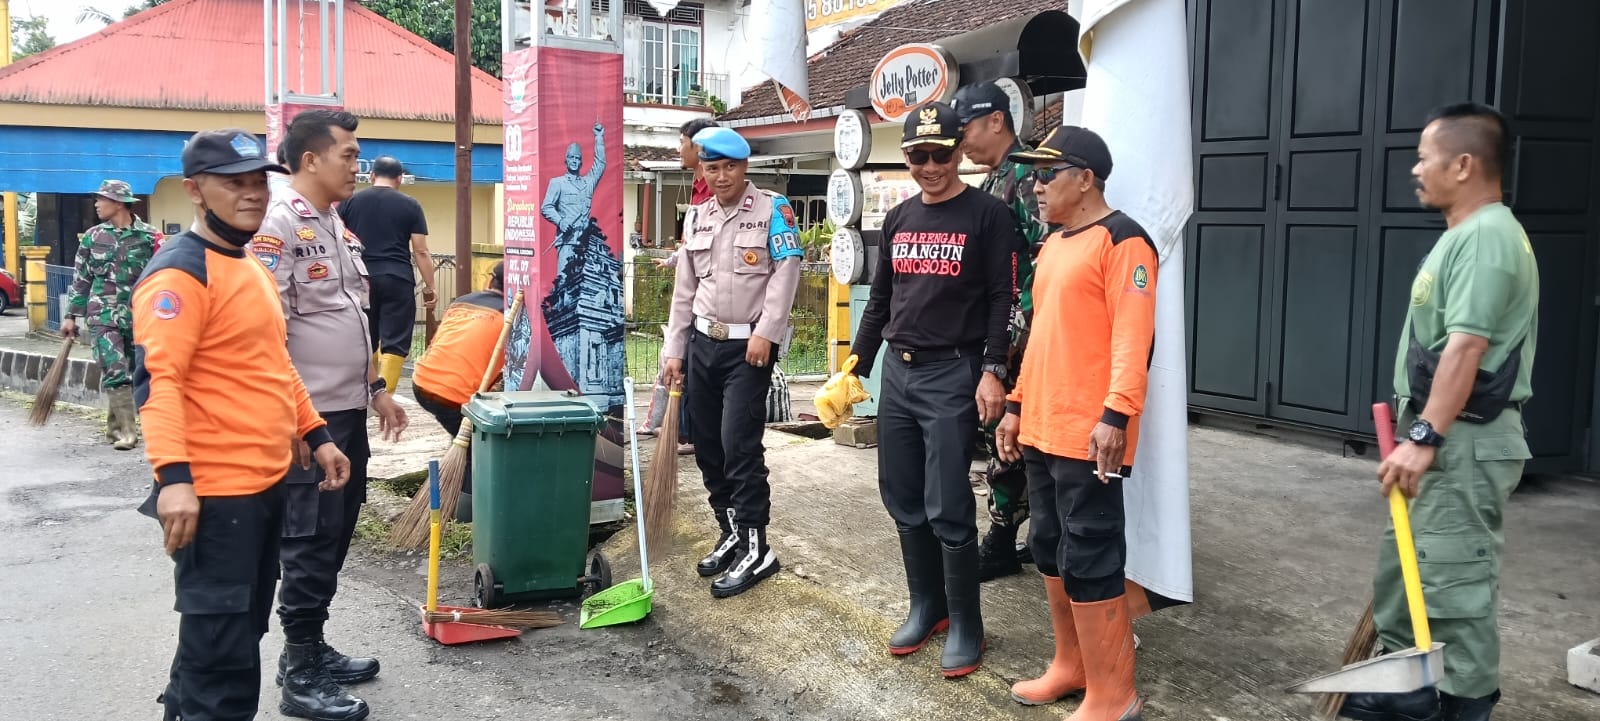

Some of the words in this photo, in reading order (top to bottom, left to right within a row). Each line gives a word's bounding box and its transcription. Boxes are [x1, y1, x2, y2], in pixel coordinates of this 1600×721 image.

[880, 71, 904, 100] Jelly
[905, 64, 938, 92] Potter
[507, 215, 535, 228] REPUBLIK
[740, 221, 767, 230] POLRI
[505, 228, 536, 241] INDONESIA
[893, 232, 967, 246] SESARENGAN
